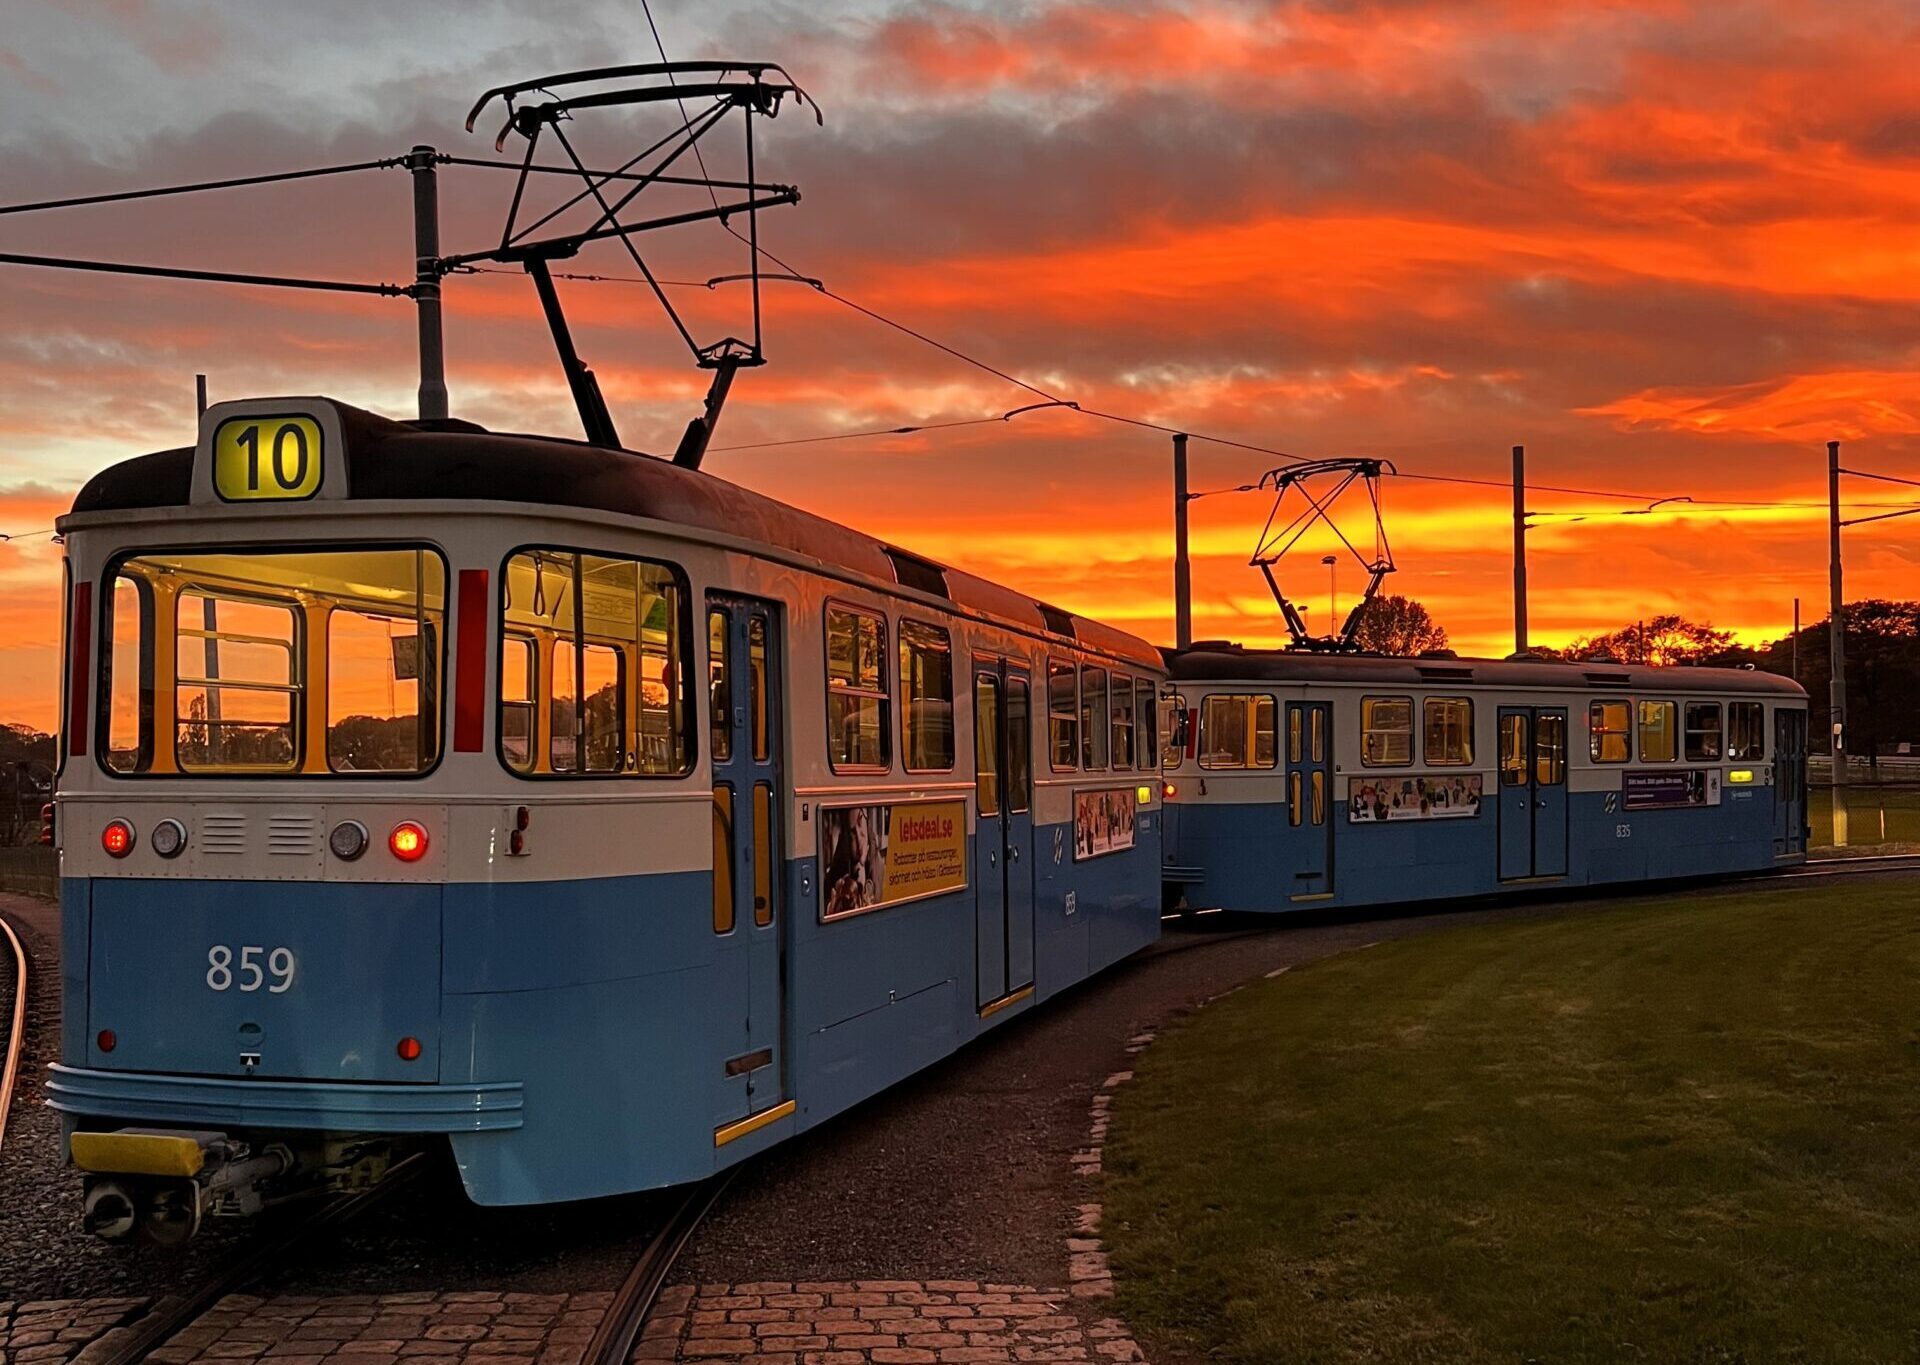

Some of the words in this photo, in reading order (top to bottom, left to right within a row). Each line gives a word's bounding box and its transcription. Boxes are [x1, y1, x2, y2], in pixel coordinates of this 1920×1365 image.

[236, 423, 308, 491] 10
[899, 815, 953, 843] letsdeal.se
[1616, 824, 1631, 838] 835
[206, 945, 295, 993] 859
